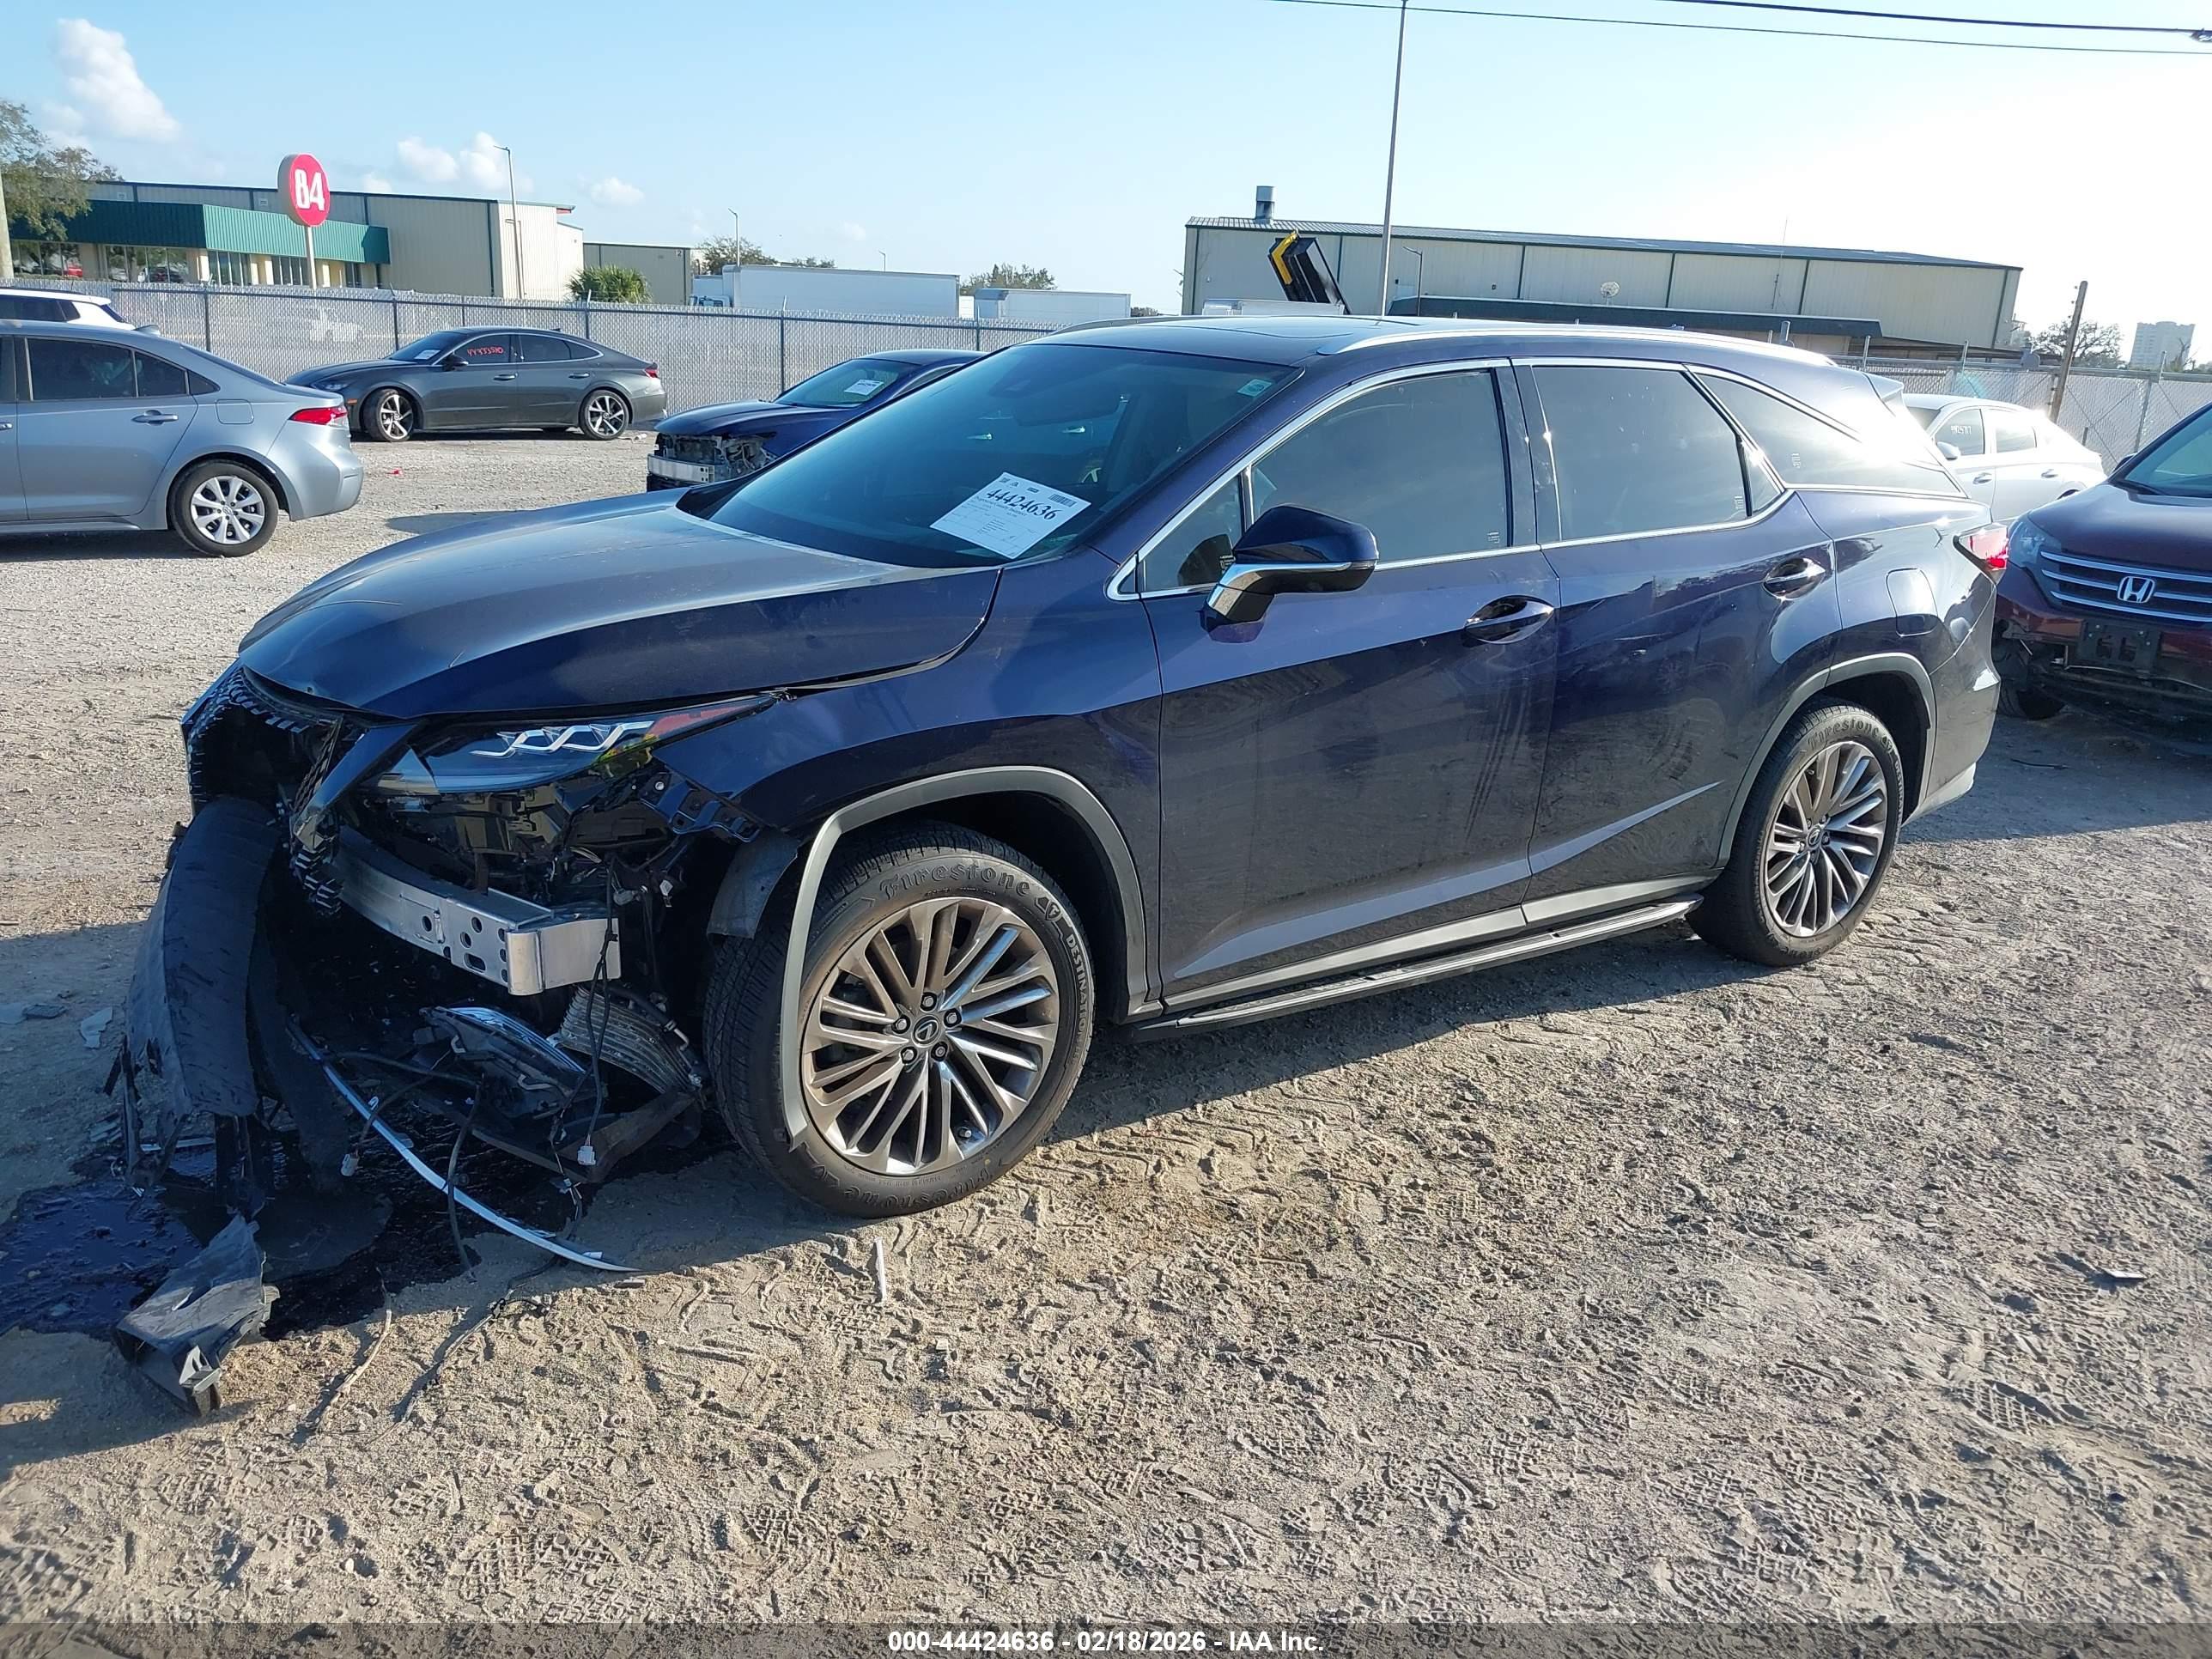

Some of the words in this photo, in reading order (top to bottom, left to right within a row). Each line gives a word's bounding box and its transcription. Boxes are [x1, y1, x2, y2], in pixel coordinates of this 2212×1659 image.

[986, 488, 1060, 520] 44424636
[879, 863, 1031, 901] Firestone
[1066, 933, 1088, 1042] DESTINATION
